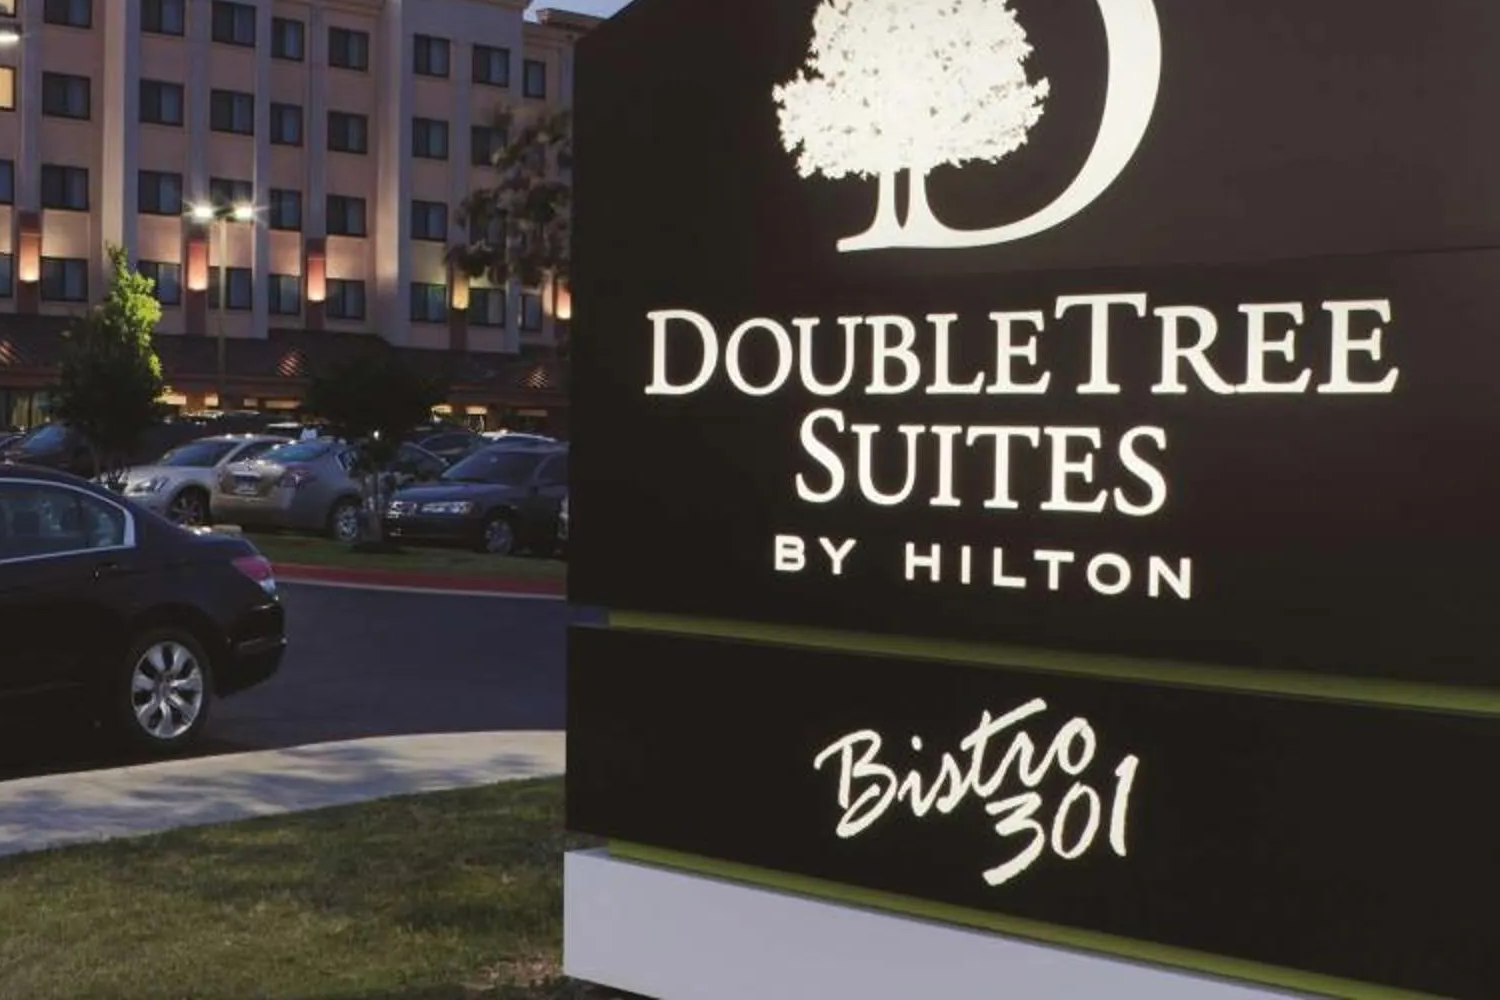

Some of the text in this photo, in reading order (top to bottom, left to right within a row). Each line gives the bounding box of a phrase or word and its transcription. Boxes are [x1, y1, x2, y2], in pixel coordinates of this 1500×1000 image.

[643, 291, 1400, 397] DOUBLETREE
[795, 406, 1168, 518] SUITES
[774, 533, 1193, 601] BY HILTON
[812, 696, 1098, 839] Bistro
[981, 753, 1140, 887] 301
